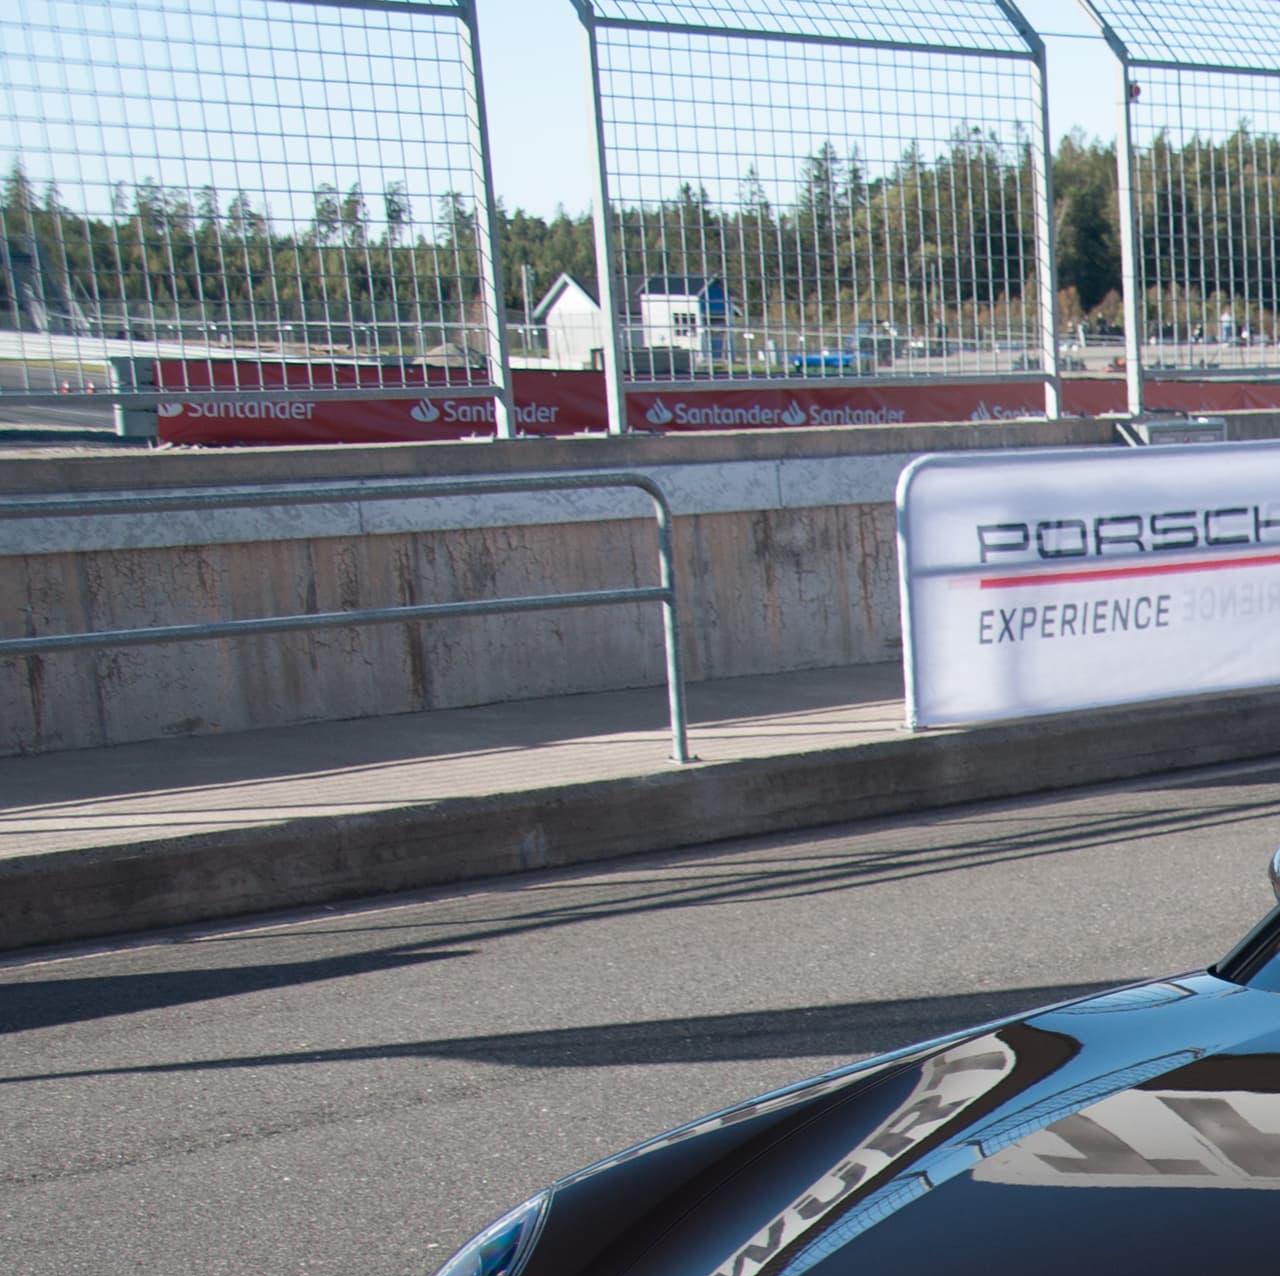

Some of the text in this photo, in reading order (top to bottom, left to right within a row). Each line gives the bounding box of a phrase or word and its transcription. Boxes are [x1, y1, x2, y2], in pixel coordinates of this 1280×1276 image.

[187, 400, 315, 419] Santander
[443, 401, 559, 423] Santnder
[675, 403, 783, 425] Santander
[809, 405, 904, 425] Santander
[979, 595, 1172, 645] EXPERIENCE
